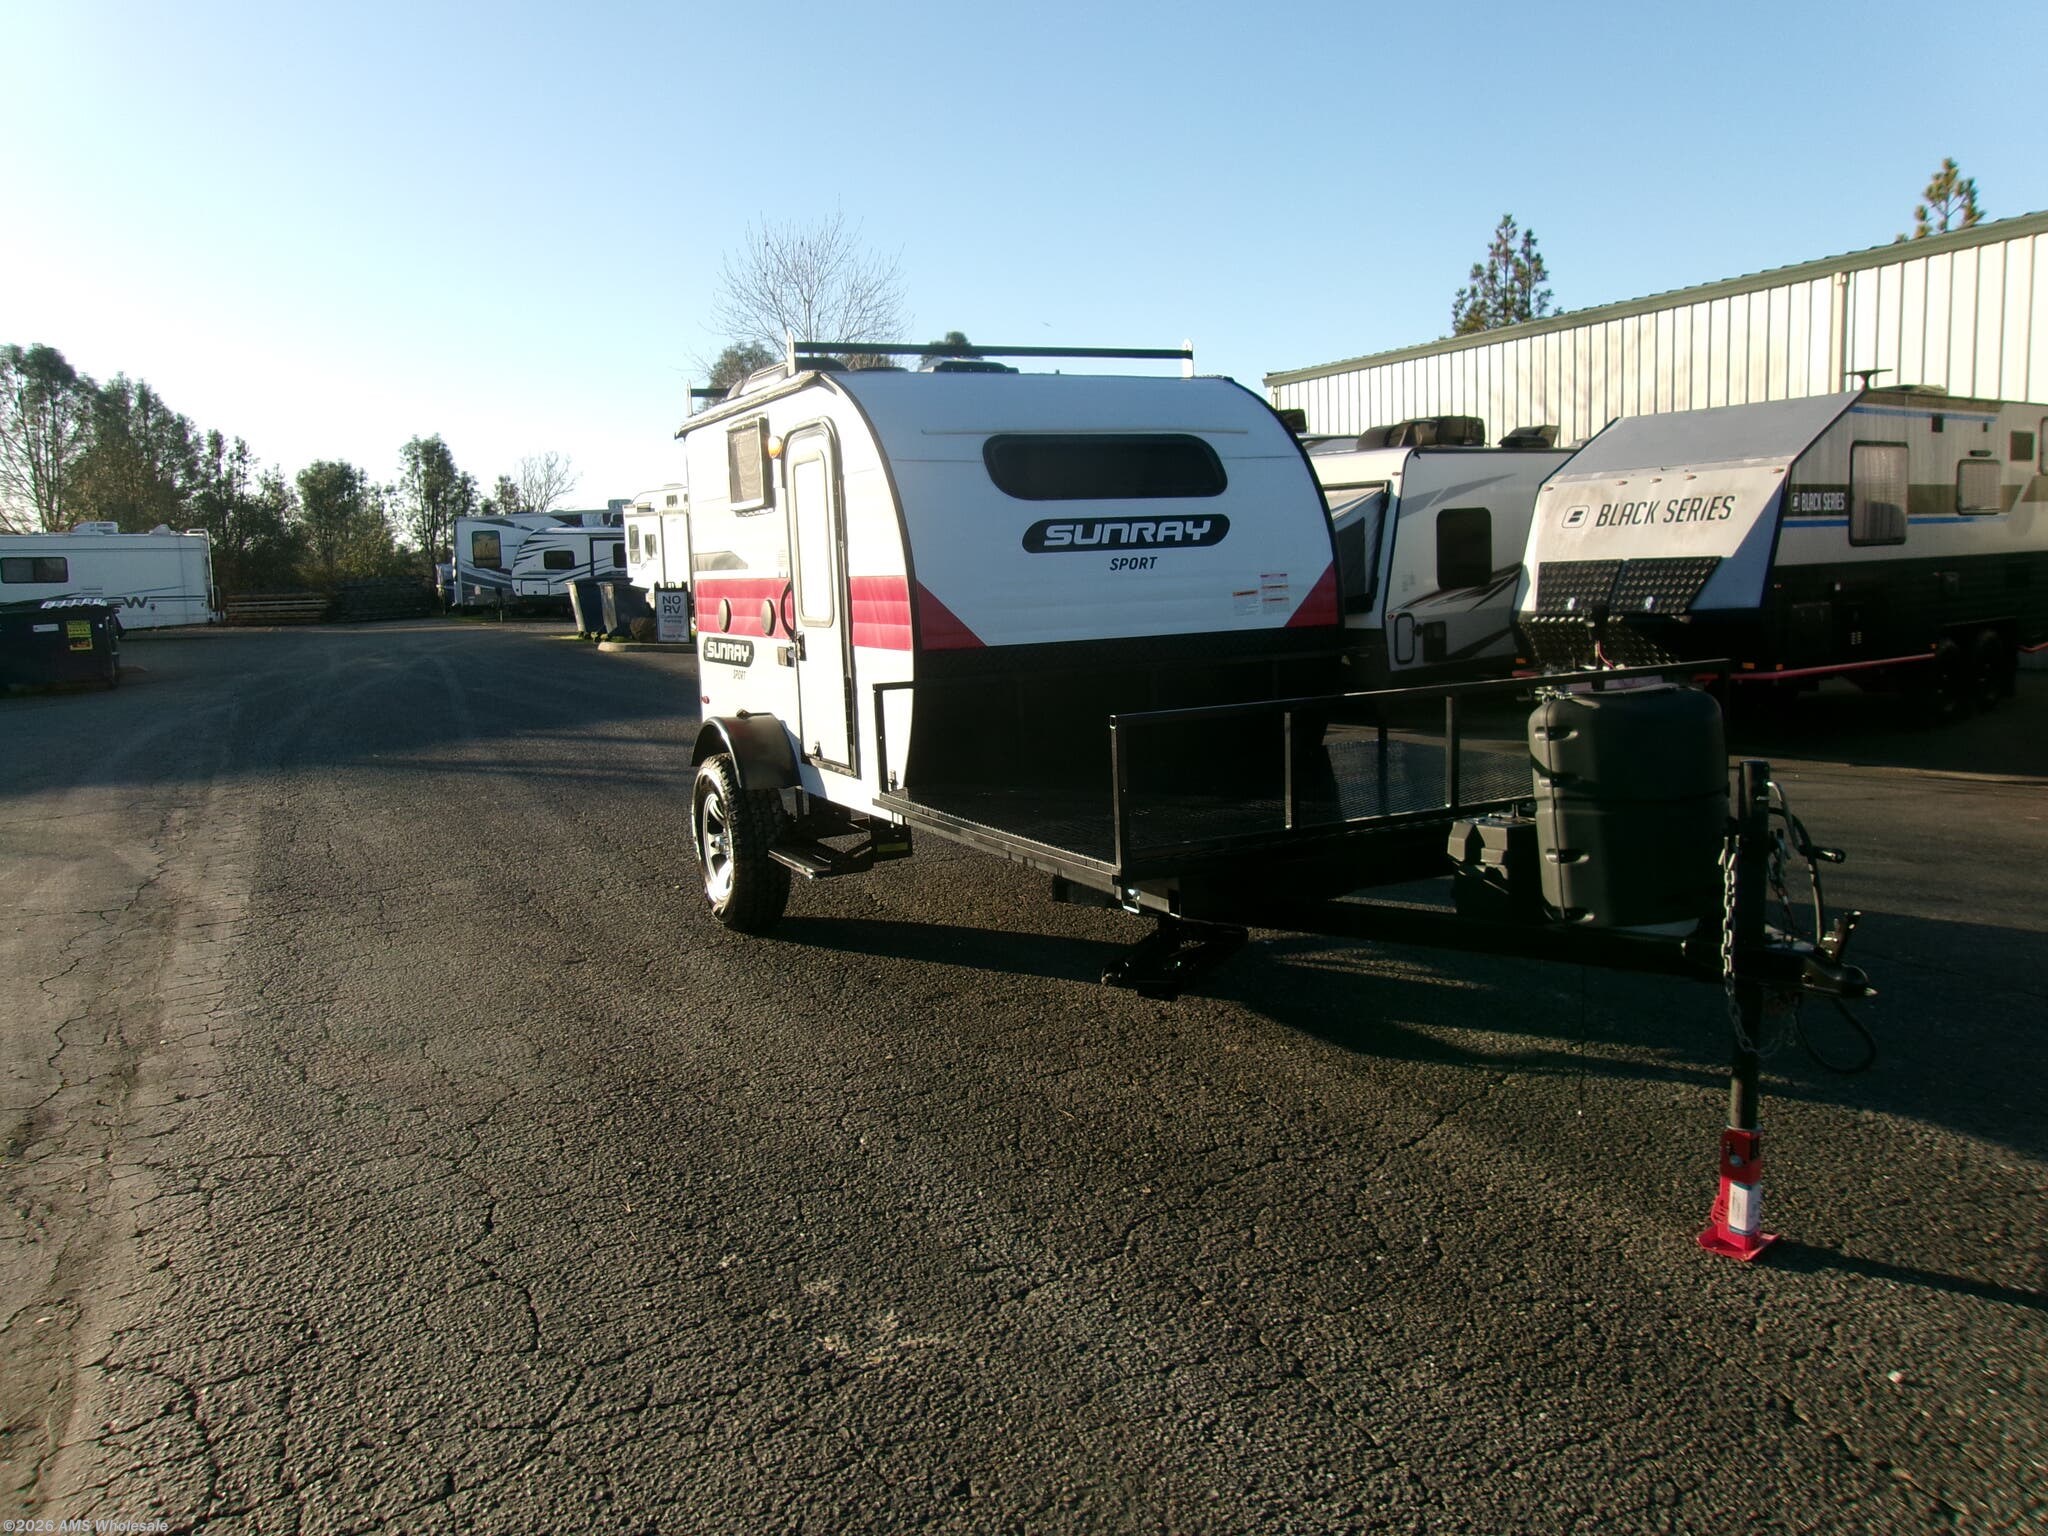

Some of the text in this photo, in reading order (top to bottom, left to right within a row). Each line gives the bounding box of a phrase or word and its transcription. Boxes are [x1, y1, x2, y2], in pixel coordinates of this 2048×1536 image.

[1595, 495, 1736, 527] BLACK SERIES
[1801, 492, 1845, 512] BLACK SERIES
[1043, 519, 1212, 546] SUNRAY
[1109, 556, 1158, 571] SPORT
[662, 595, 681, 605] NO
[663, 604, 681, 614] RV
[706, 641, 750, 662] SUNRAY
